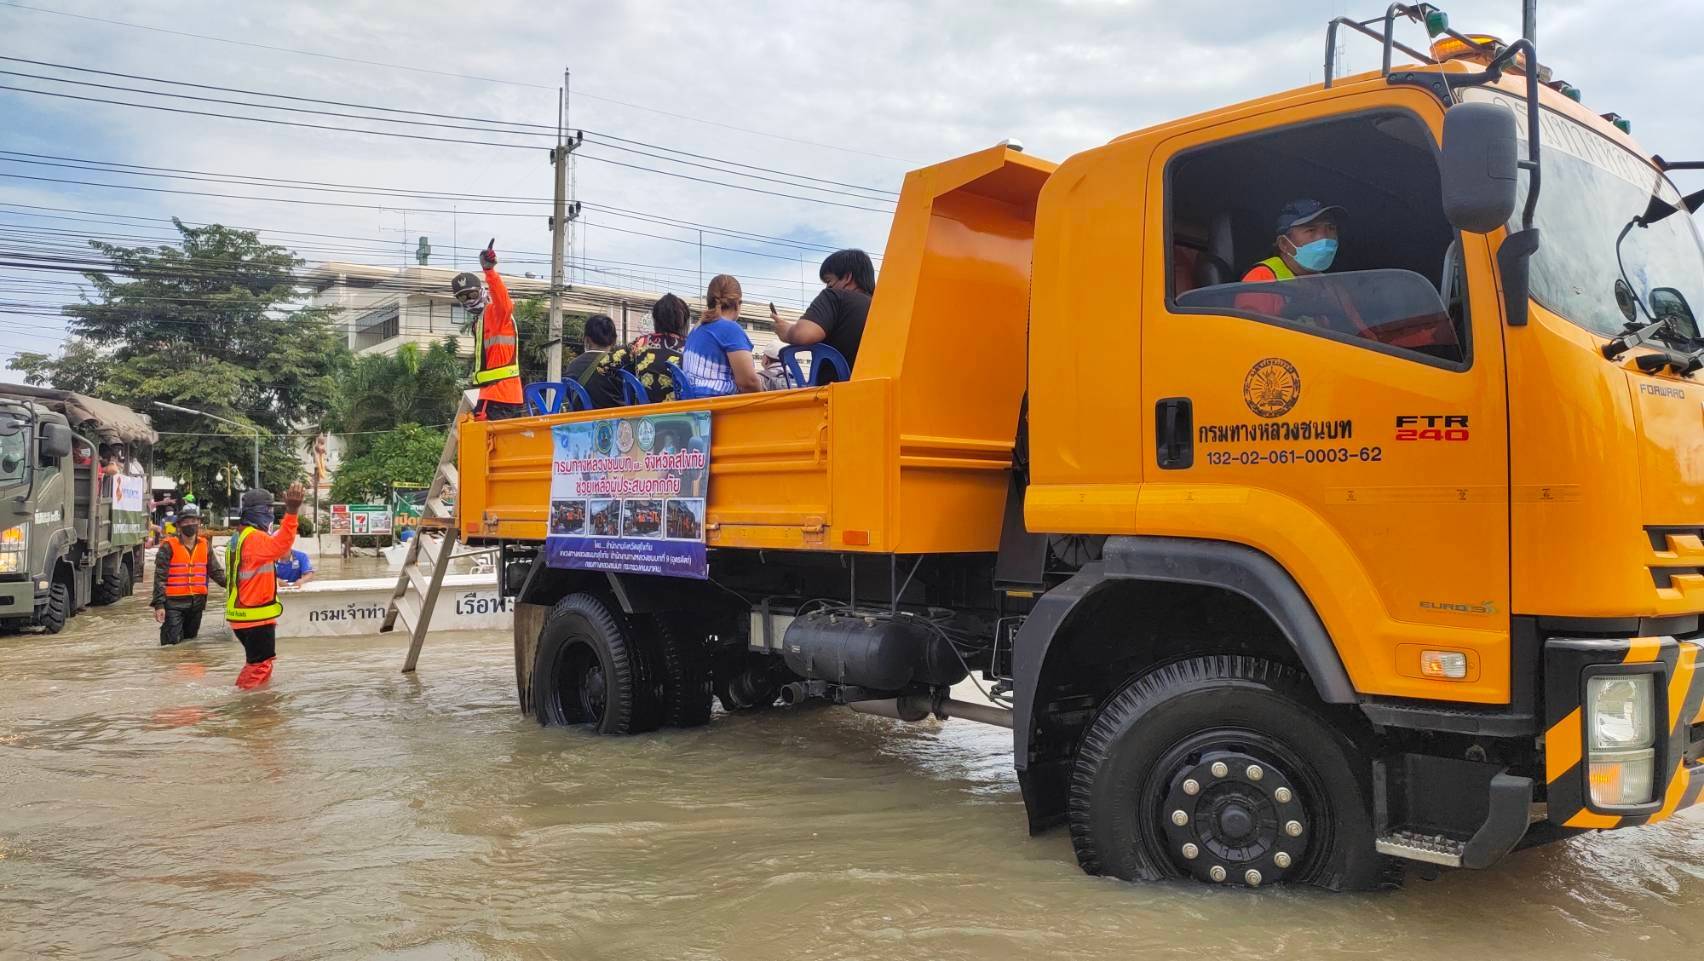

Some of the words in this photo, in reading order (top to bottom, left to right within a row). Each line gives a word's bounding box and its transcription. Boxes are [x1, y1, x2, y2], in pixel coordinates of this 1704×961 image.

[1640, 383, 1685, 399] FORWARD
[1395, 415, 1470, 428] FTR
[1198, 418, 1353, 443] กรมทางหลวงชนบท
[1395, 429, 1470, 441] 240
[1206, 446, 1382, 465] 132-02-061-0003-62
[309, 602, 386, 622] กรมเจ้าท่า
